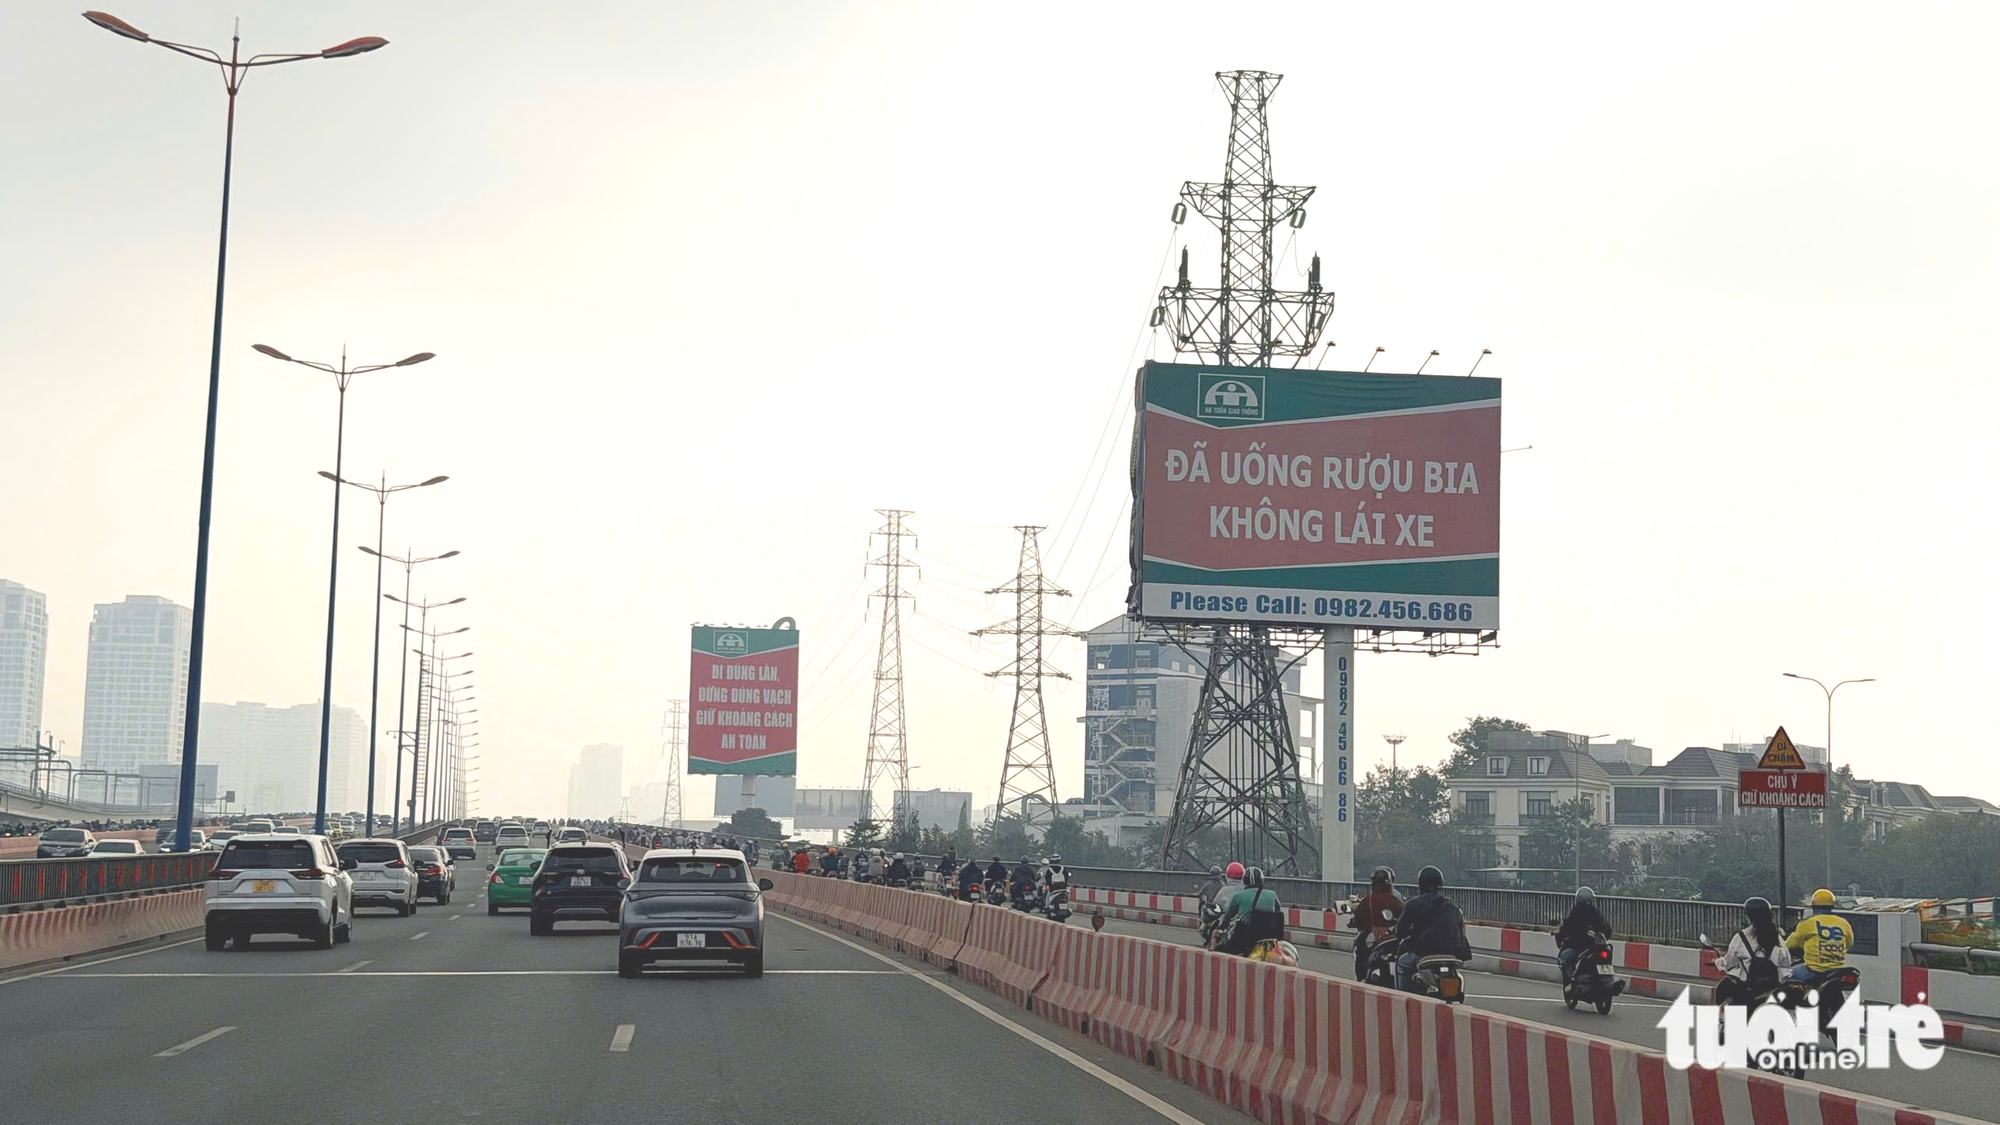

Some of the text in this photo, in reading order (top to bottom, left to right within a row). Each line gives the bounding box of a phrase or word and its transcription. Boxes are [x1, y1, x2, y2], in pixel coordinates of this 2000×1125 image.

[1166, 441, 1210, 482] ĐÃ
[1221, 442, 1312, 488] UỐNG
[1323, 452, 1413, 500] RƯỢU
[1424, 460, 1479, 494] BIA
[1209, 496, 1434, 547] KHÔNG LÁI XE
[1170, 591, 1473, 622] Please Call: 0982.456.686
[1338, 656, 1347, 716] 0982
[763, 689, 792, 707] VẠCH
[696, 707, 793, 728] GIỮ KHOẢNG CÁCH
[721, 732, 767, 750] AN TOÀN
[1741, 789, 1758, 805] GIỮ
[1798, 790, 1824, 807] CÁCH
[1816, 920, 1844, 941] be
